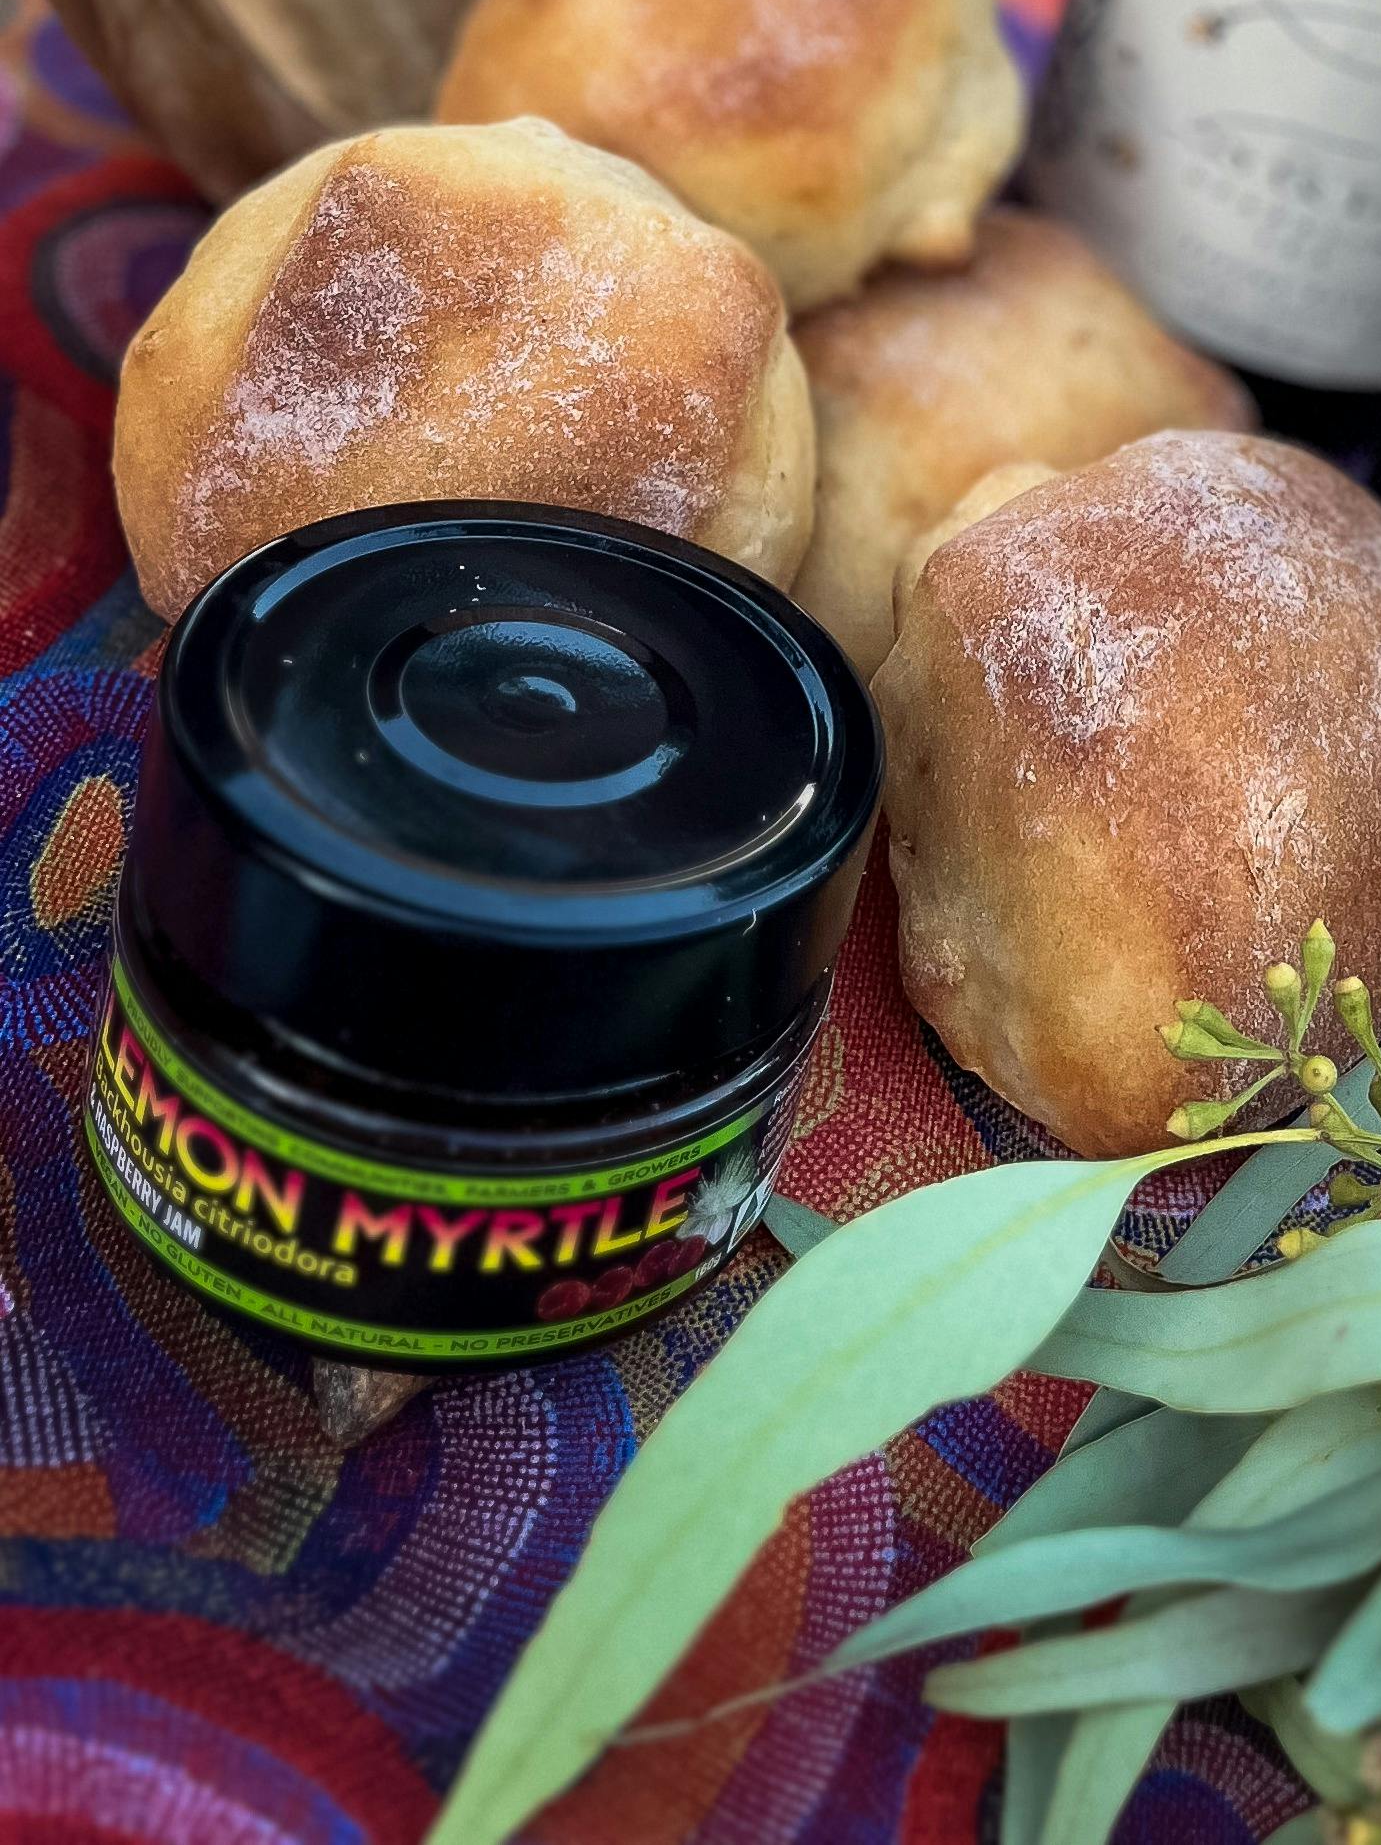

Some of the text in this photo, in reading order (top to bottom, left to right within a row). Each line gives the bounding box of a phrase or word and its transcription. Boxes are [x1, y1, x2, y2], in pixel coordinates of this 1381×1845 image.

[95, 1049, 188, 1204] Backhousia
[194, 1197, 359, 1288] citriodora
[95, 1099, 163, 1216] RASPBERRY
[163, 1204, 203, 1250] JAM
[100, 989, 306, 1235] LEMON
[331, 1166, 701, 1273] MYRTLE
[465, 1146, 701, 1199] FARMERS & GROWERS
[138, 1214, 163, 1244] NO
[166, 1240, 242, 1302] GLUTEN
[262, 1299, 304, 1328] ALL
[311, 1317, 425, 1352] NATURAL
[451, 1337, 489, 1353] NO
[498, 1287, 673, 1350] PRESERVATIVES
